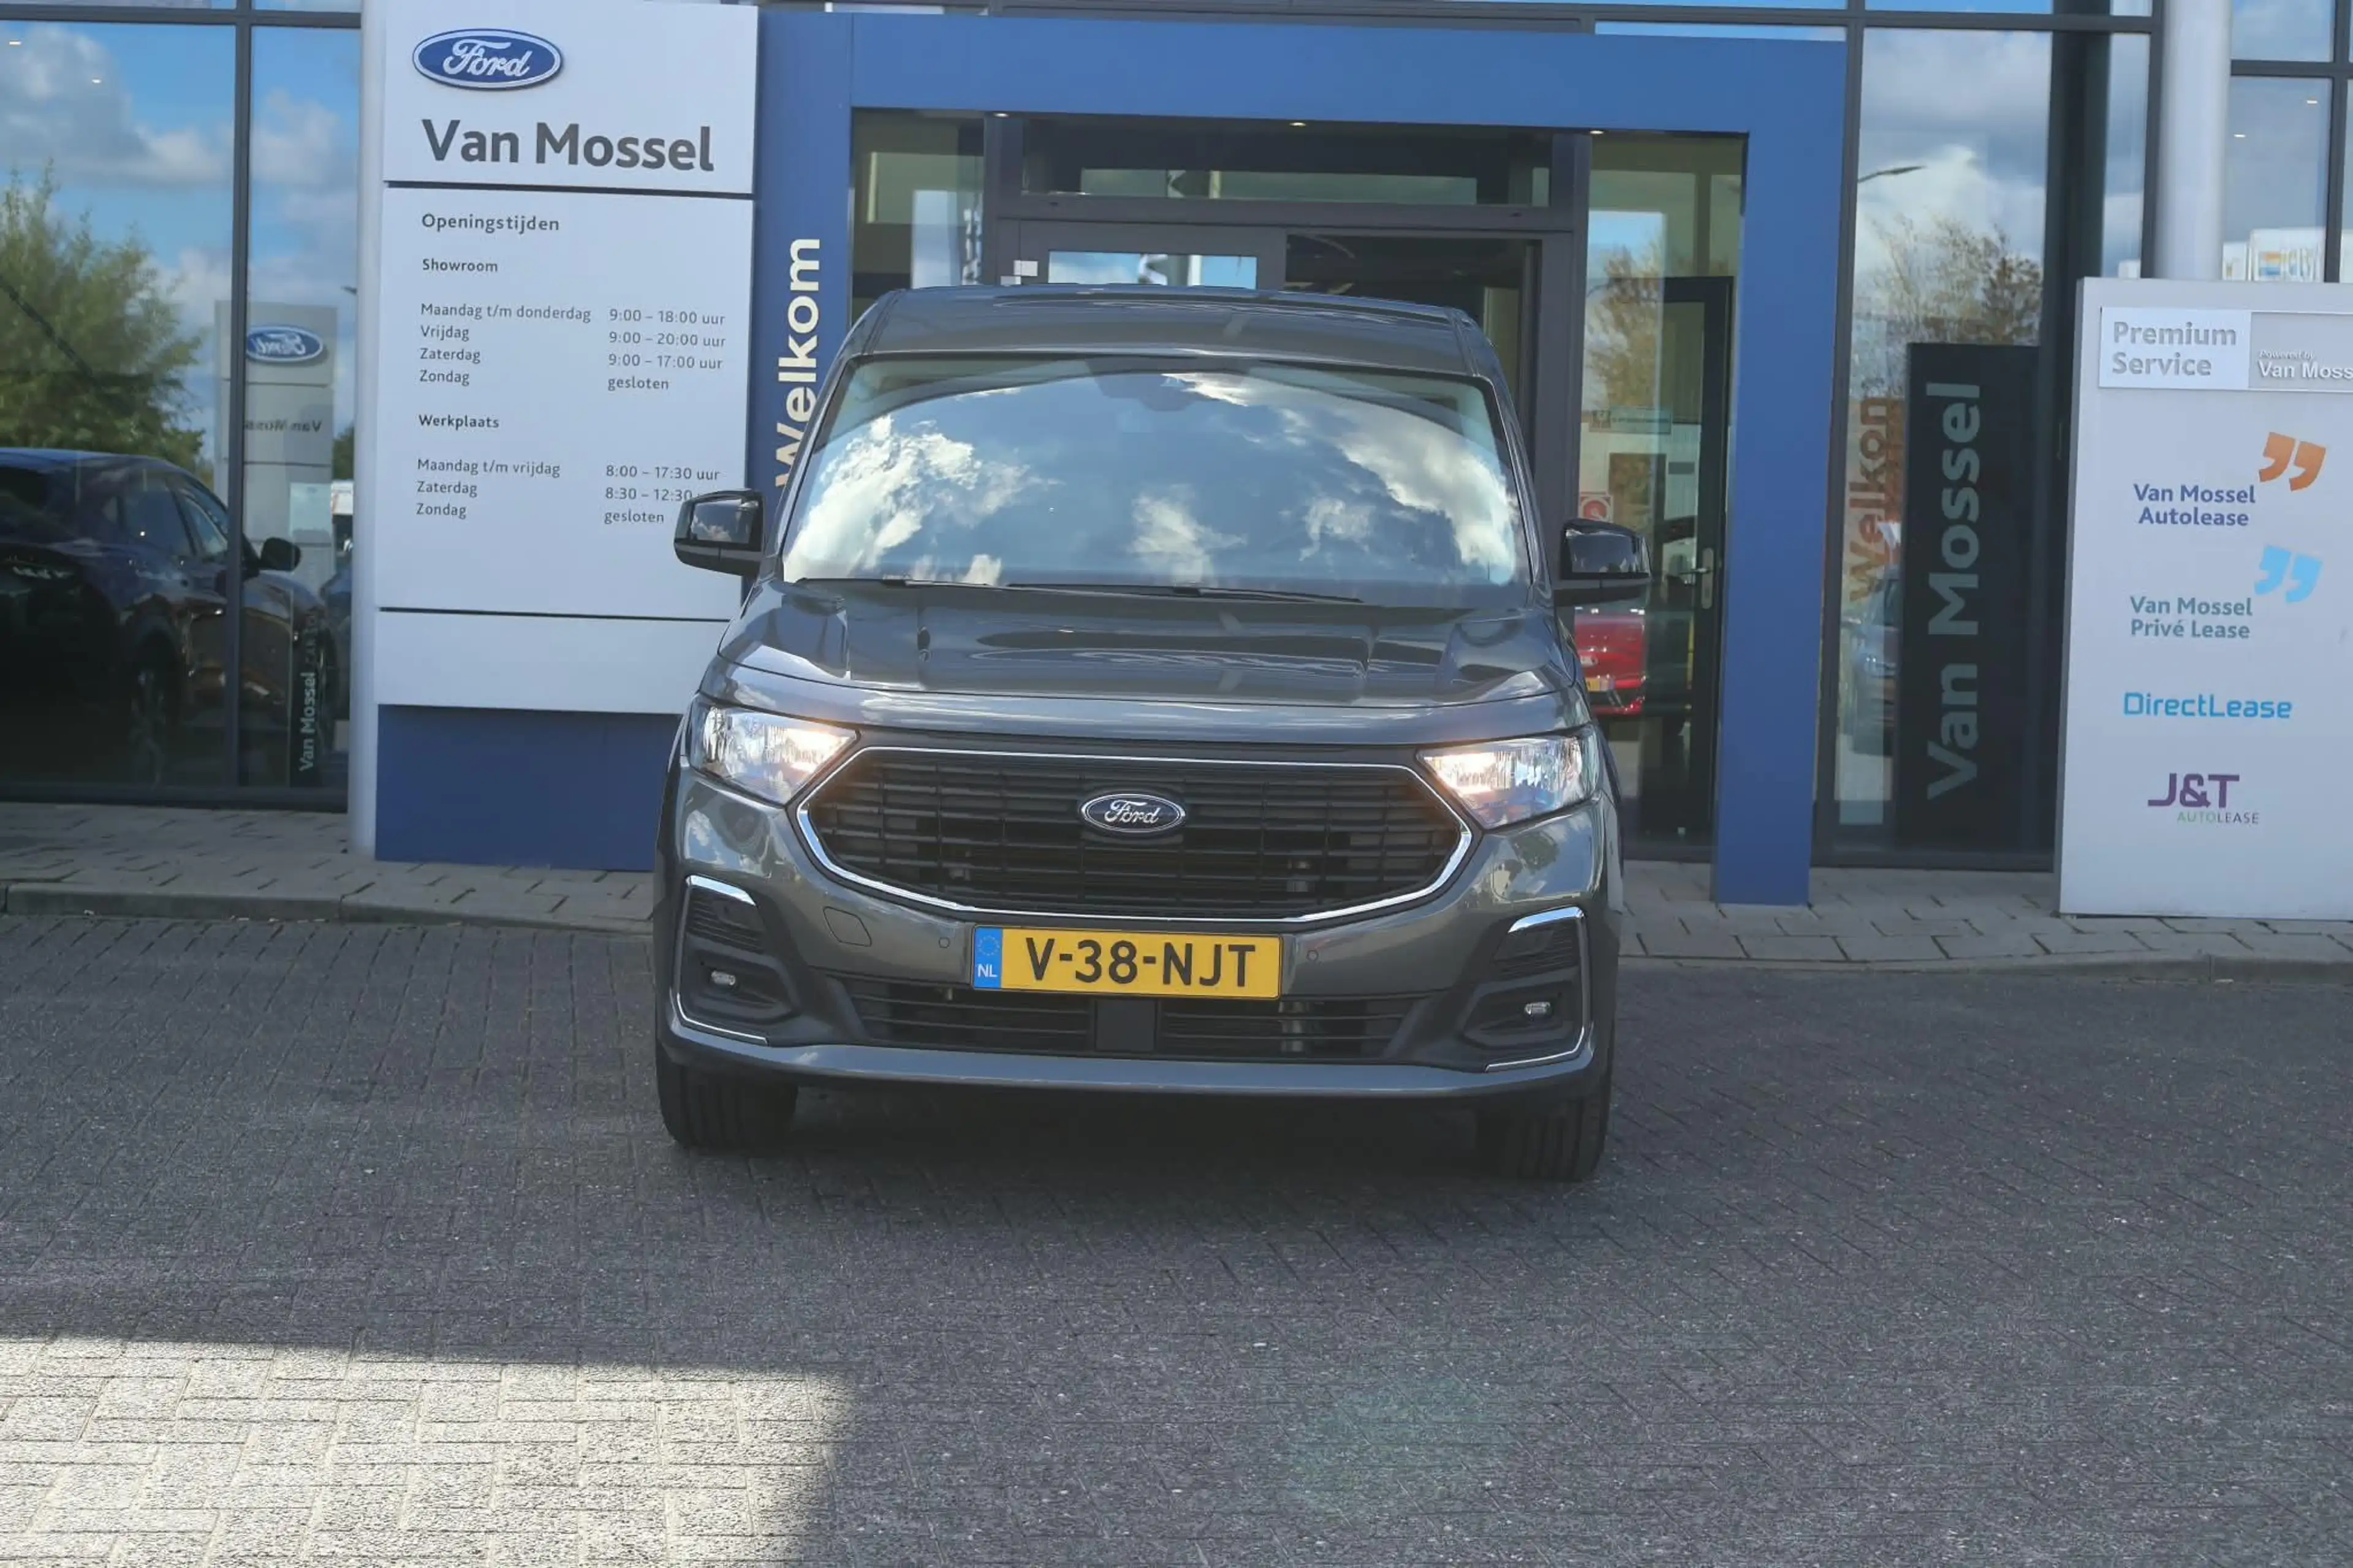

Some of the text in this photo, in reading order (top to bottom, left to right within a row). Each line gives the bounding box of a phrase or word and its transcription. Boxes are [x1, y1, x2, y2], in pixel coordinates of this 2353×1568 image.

[443, 38, 533, 78] Ford
[422, 119, 714, 172] Van Mossel
[422, 213, 559, 234] Openingstijden
[422, 258, 498, 273] Showroom
[421, 303, 591, 324] Maandag t/m donderdag
[610, 308, 642, 322] 9:00
[658, 311, 697, 324] 18:00
[702, 314, 726, 325] uur
[421, 325, 469, 343] Vrijdag
[609, 331, 641, 344] 9:00
[657, 333, 698, 346] 20:00
[703, 337, 726, 347] uur
[2113, 321, 2237, 346] Premium
[420, 348, 480, 364] Zaterdag
[608, 354, 641, 366] 9:00
[657, 355, 695, 369] 17:00
[699, 359, 723, 369] uur
[2112, 352, 2212, 376] Service
[420, 369, 470, 387] Zondag
[2258, 360, 2295, 378] Van
[607, 376, 669, 392] gesloten
[419, 414, 499, 430] Werkplaats
[417, 459, 560, 478] Maandag t/m vrijdag
[606, 464, 638, 478] 8:00
[654, 467, 692, 480] 17:30
[697, 470, 720, 480] uur
[417, 480, 477, 498] Zaterdag
[605, 487, 637, 500] 8:30
[654, 489, 692, 502] 12:30
[2134, 483, 2256, 503] Van Mossel
[416, 502, 466, 520] Zondag
[604, 509, 664, 525] gesloten
[2138, 507, 2249, 526] Autolease
[1925, 382, 1980, 800] Van Mossel
[2130, 596, 2253, 616] Van Mossel
[2131, 618, 2251, 638] Privé Lease
[300, 672, 316, 733] Mossel
[2124, 692, 2293, 719] DirectLease
[299, 738, 314, 772] Van
[2148, 773, 2240, 809] J&T
[1104, 798, 1160, 825] Ford
[2177, 811, 2260, 825] AUTOLEASE
[977, 937, 1256, 987] NL V-38-NJT
